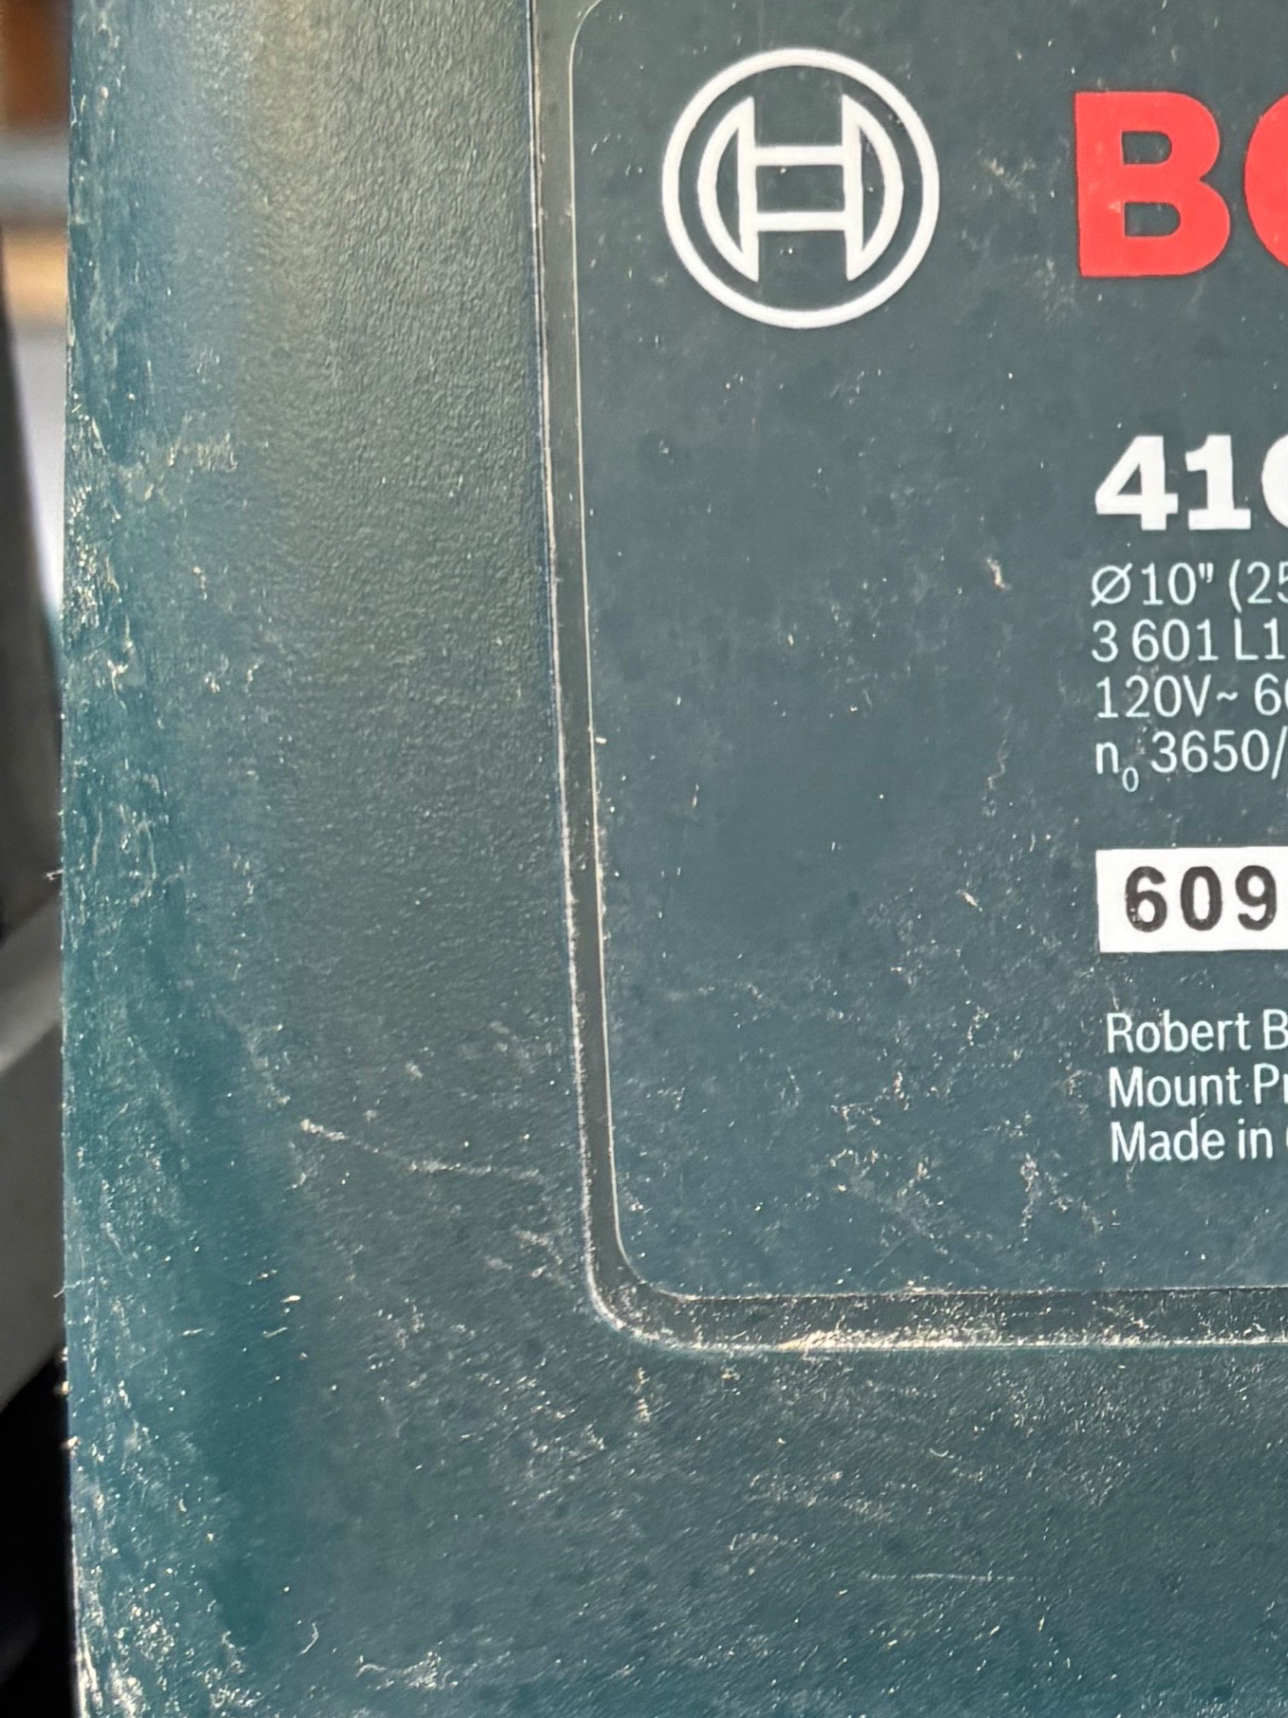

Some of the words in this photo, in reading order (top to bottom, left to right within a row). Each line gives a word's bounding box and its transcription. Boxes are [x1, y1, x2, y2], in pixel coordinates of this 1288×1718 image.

[1107, 1010, 1251, 1053] Robert
[1109, 1067, 1242, 1107] Mount
[1111, 1119, 1225, 1162] Made
[1239, 1116, 1272, 1159] in
